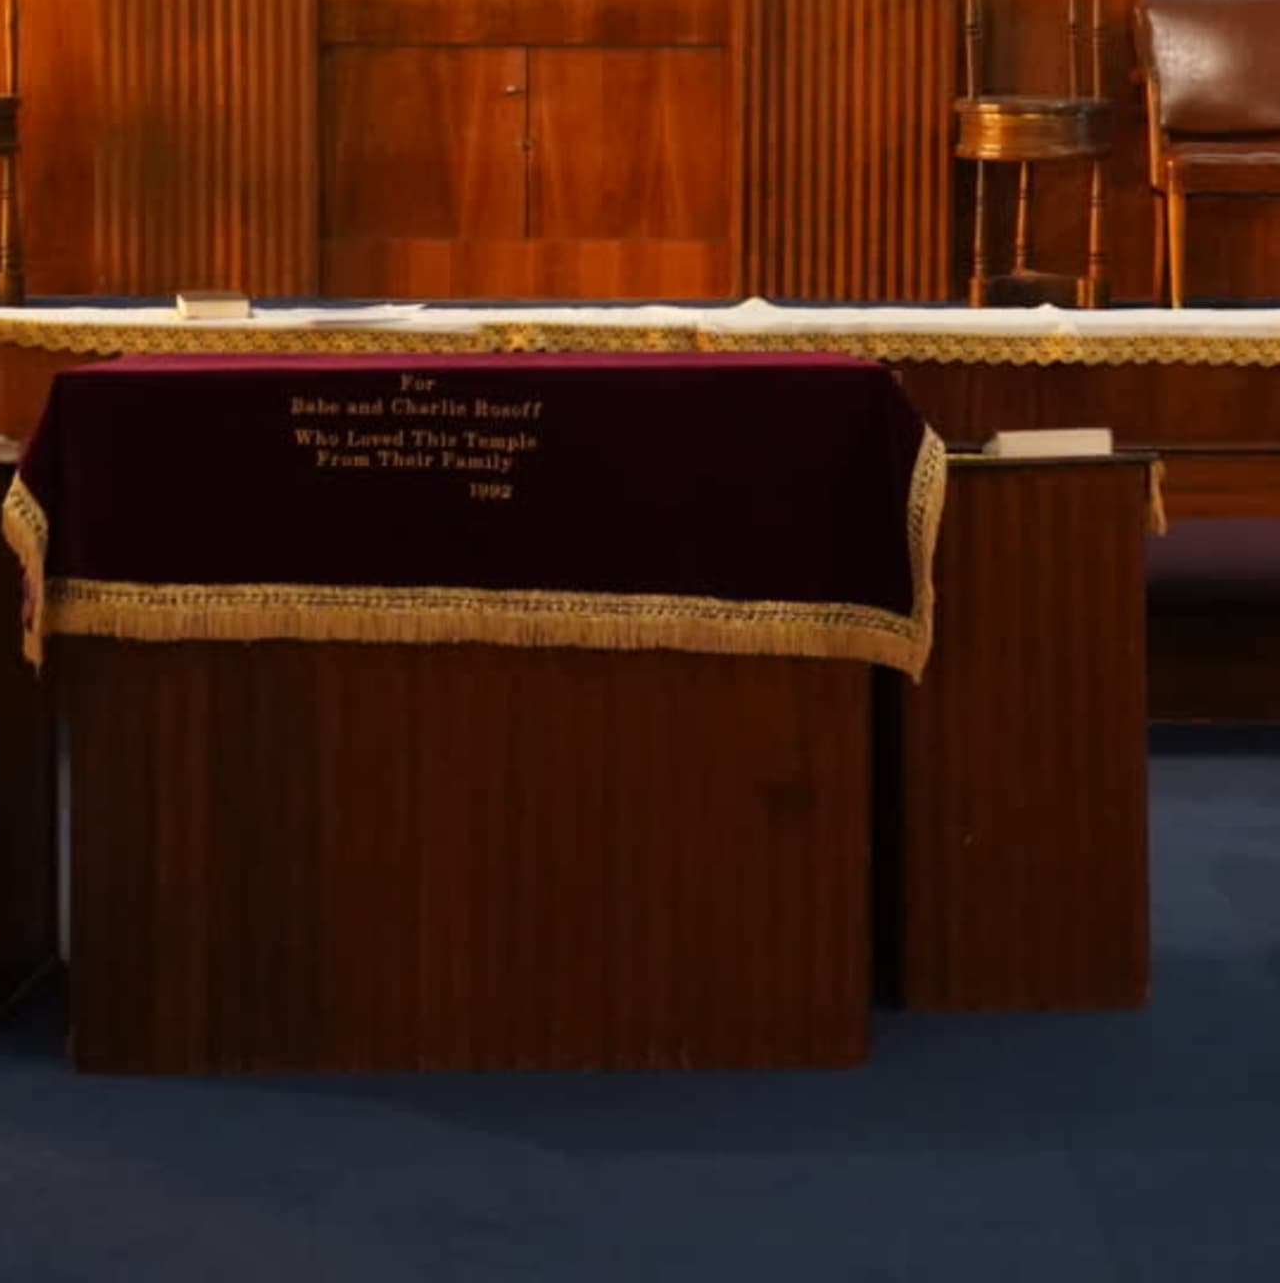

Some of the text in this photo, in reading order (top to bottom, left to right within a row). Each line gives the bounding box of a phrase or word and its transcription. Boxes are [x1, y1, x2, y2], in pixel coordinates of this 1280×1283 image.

[400, 373, 436, 391] For
[347, 397, 384, 415] and
[391, 398, 467, 417] Charlie
[294, 429, 537, 452] Who Loved This Temple
[316, 450, 513, 474] From Their Family
